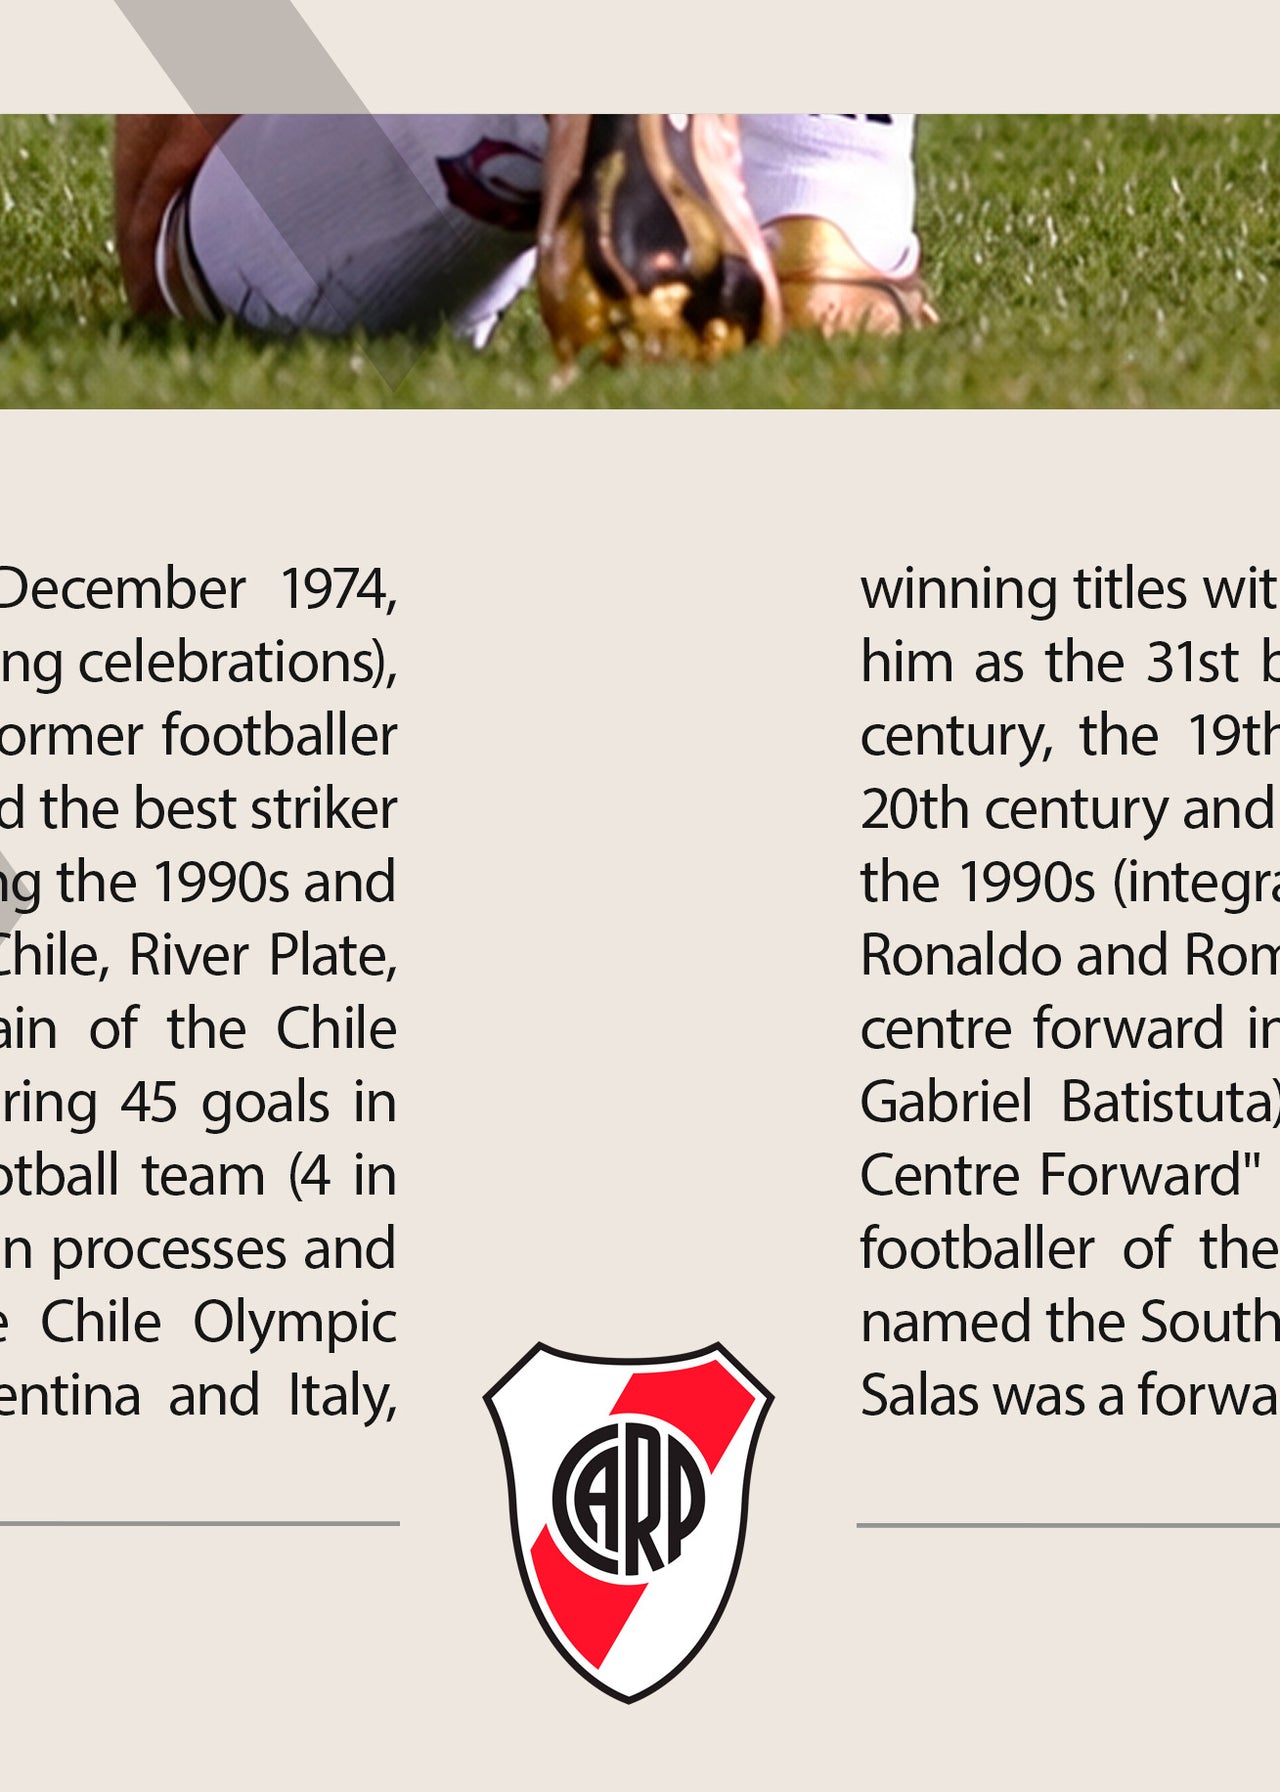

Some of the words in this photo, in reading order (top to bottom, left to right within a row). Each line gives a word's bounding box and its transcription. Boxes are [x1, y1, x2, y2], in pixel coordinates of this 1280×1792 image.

[283, 567, 397, 616] 1974,
[860, 565, 1057, 622] winning
[1073, 563, 1187, 610] titles
[79, 636, 397, 689] celebrations),
[861, 715, 1053, 768] century,
[1078, 710, 1159, 756] the
[39, 783, 119, 830] the
[135, 783, 237, 830] best
[251, 783, 398, 830] striker
[859, 856, 940, 903] the
[961, 860, 1095, 903] 1990s
[132, 932, 250, 976] River
[272, 930, 397, 982] Plate,
[90, 1003, 141, 1050] of
[166, 1003, 246, 1050] the
[277, 1003, 397, 1050] Chile
[861, 1009, 1012, 1050] centre
[1032, 1003, 1223, 1050] forward
[861, 1152, 1020, 1196] Centre
[1042, 1150, 1260, 1196] Forward"
[53, 1237, 287, 1281] processes
[304, 1223, 394, 1270] and
[859, 1223, 1095, 1270] footballer
[1123, 1223, 1175, 1270] of
[1199, 1223, 1279, 1270] the
[169, 1370, 259, 1417] and
[291, 1370, 397, 1428] Italy,
[861, 1370, 979, 1416] Salas
[992, 1383, 1085, 1417] was
[1098, 1383, 1124, 1416] a
[551, 1422, 706, 1577] CARP
